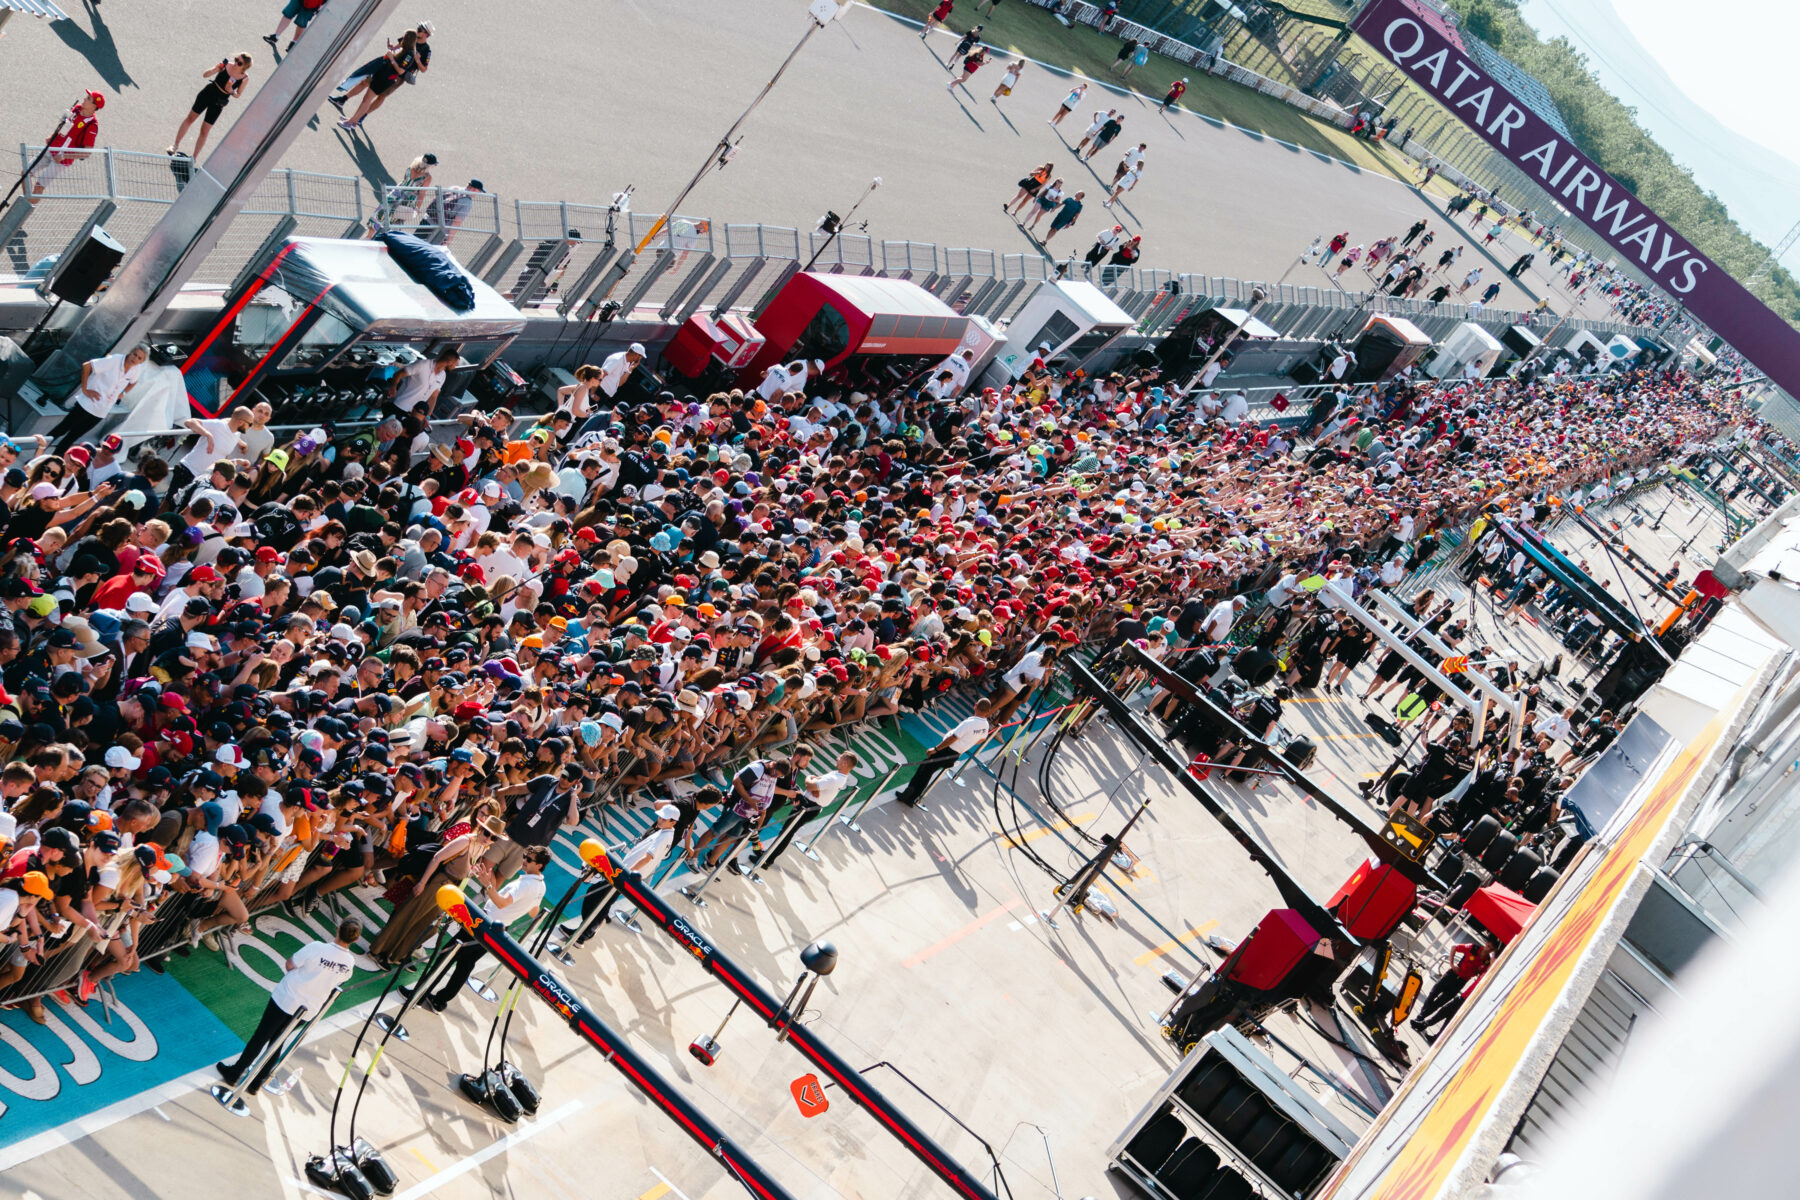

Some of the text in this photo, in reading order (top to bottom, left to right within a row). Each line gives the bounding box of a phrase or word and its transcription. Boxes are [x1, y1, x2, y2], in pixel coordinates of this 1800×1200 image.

[1383, 17, 1708, 294] QATAR AIRWAYS
[667, 924, 691, 946] Red Bull
[673, 919, 712, 955] ORACLE
[532, 979, 558, 1004] Red Bull
[539, 973, 581, 1013] ORACLE
[0, 988, 159, 1118] ara
[810, 1081, 824, 1104] BRAKES
